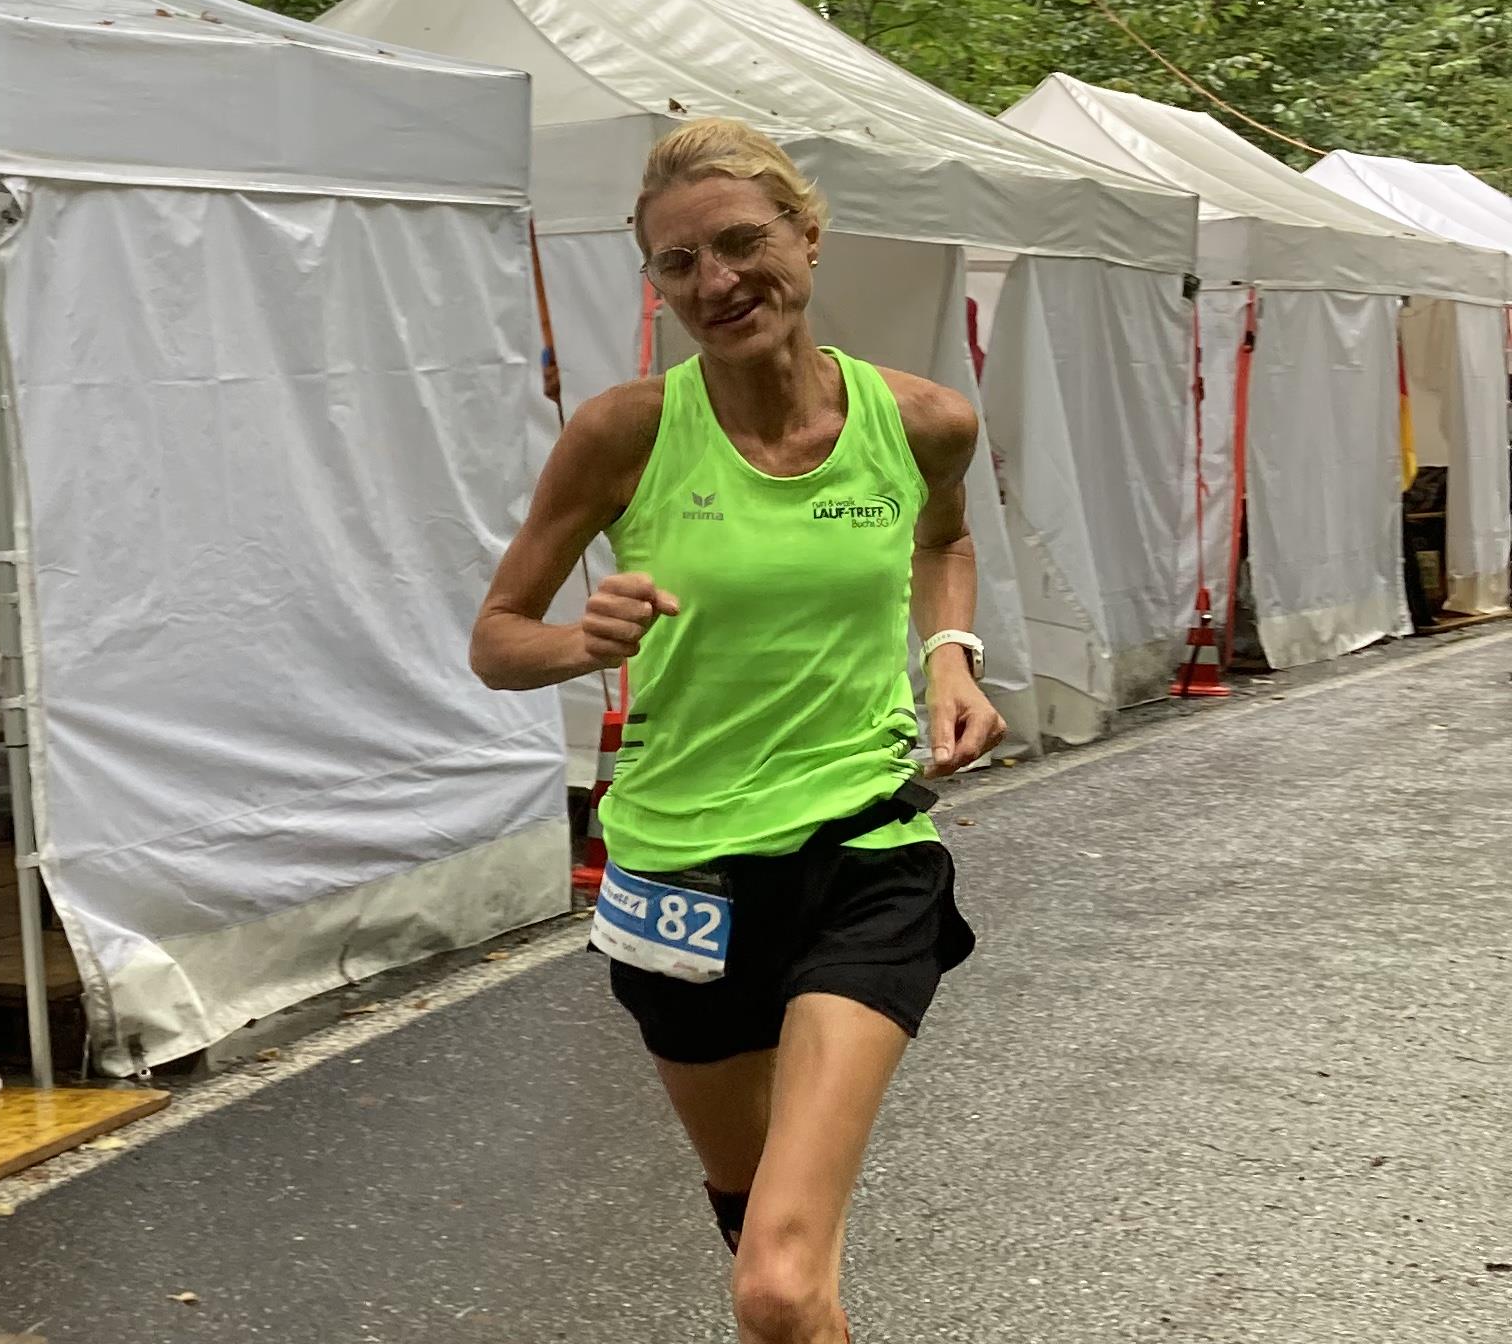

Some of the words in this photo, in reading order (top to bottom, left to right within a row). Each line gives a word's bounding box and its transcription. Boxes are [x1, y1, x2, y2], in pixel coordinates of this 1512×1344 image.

[813, 506, 884, 519] LAUF-TREFF
[876, 518, 889, 527] SG
[656, 894, 722, 952] 82
